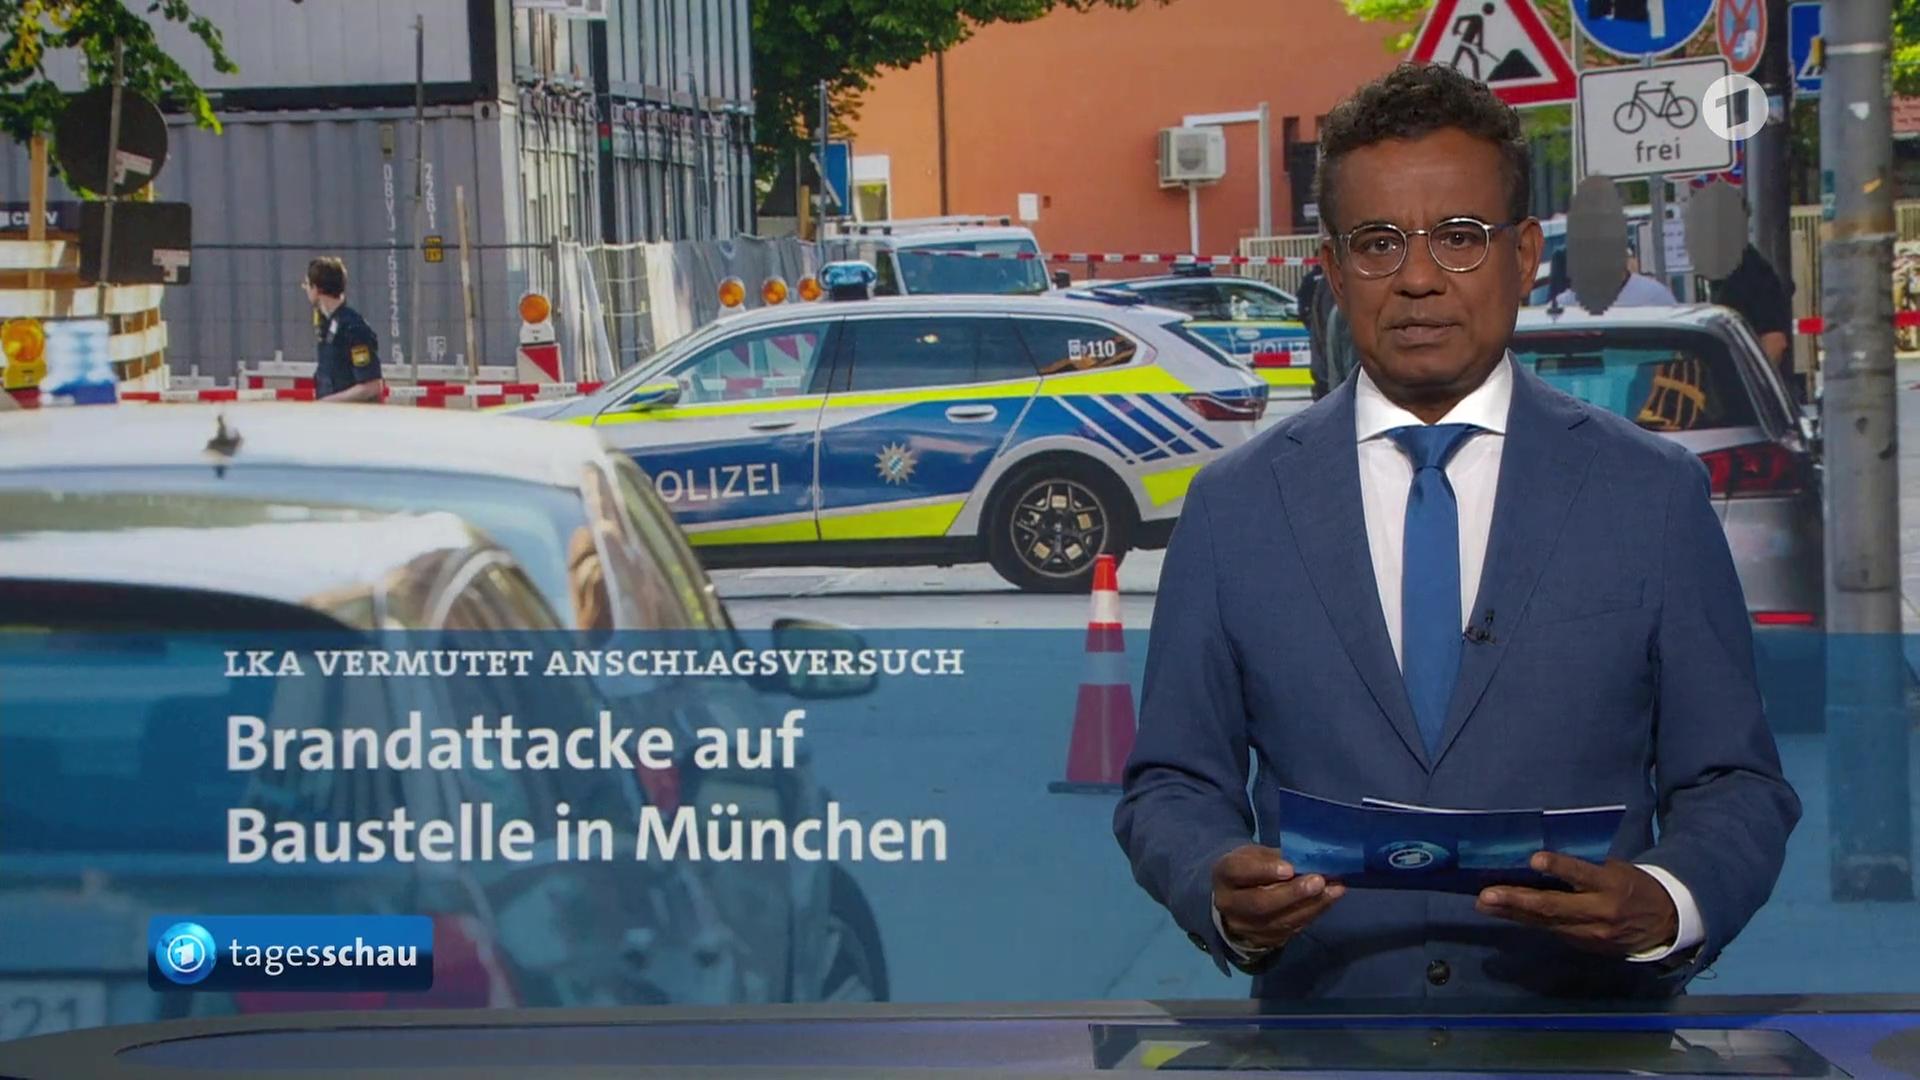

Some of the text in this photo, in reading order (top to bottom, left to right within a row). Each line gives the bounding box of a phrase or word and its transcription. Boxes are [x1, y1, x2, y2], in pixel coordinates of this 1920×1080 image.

[1635, 137, 1681, 163] frei
[1087, 340, 1116, 357] 110
[655, 463, 781, 503] OLIZEI
